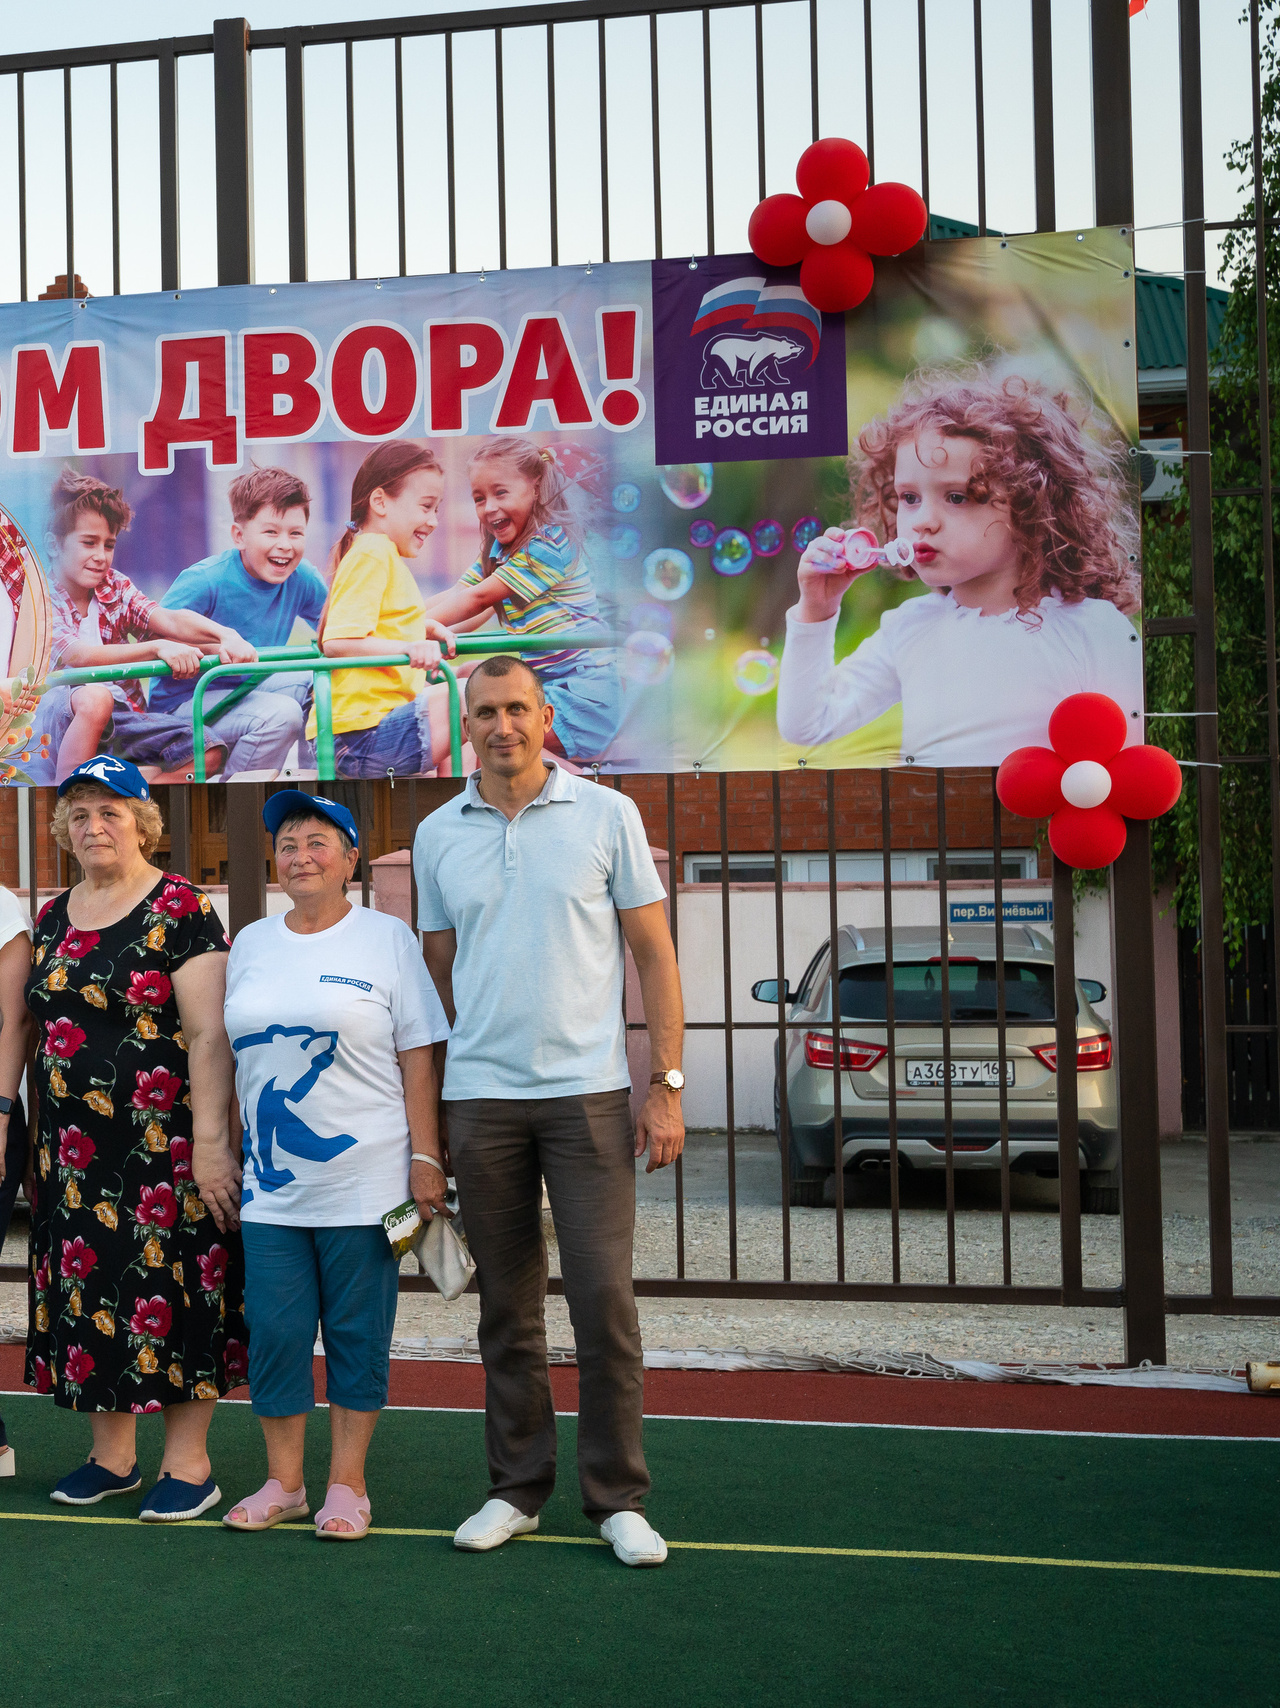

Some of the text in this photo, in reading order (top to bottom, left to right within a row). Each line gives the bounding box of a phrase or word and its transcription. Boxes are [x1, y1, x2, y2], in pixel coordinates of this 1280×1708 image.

[142, 309, 641, 471] ДВОРА!
[694, 391, 808, 417] ЕДИНАЯ
[695, 414, 809, 439] РОССИЯ
[953, 904, 1045, 920] пер.Винёвый
[321, 976, 372, 991] ЕДИНАЯ РОССИЯ
